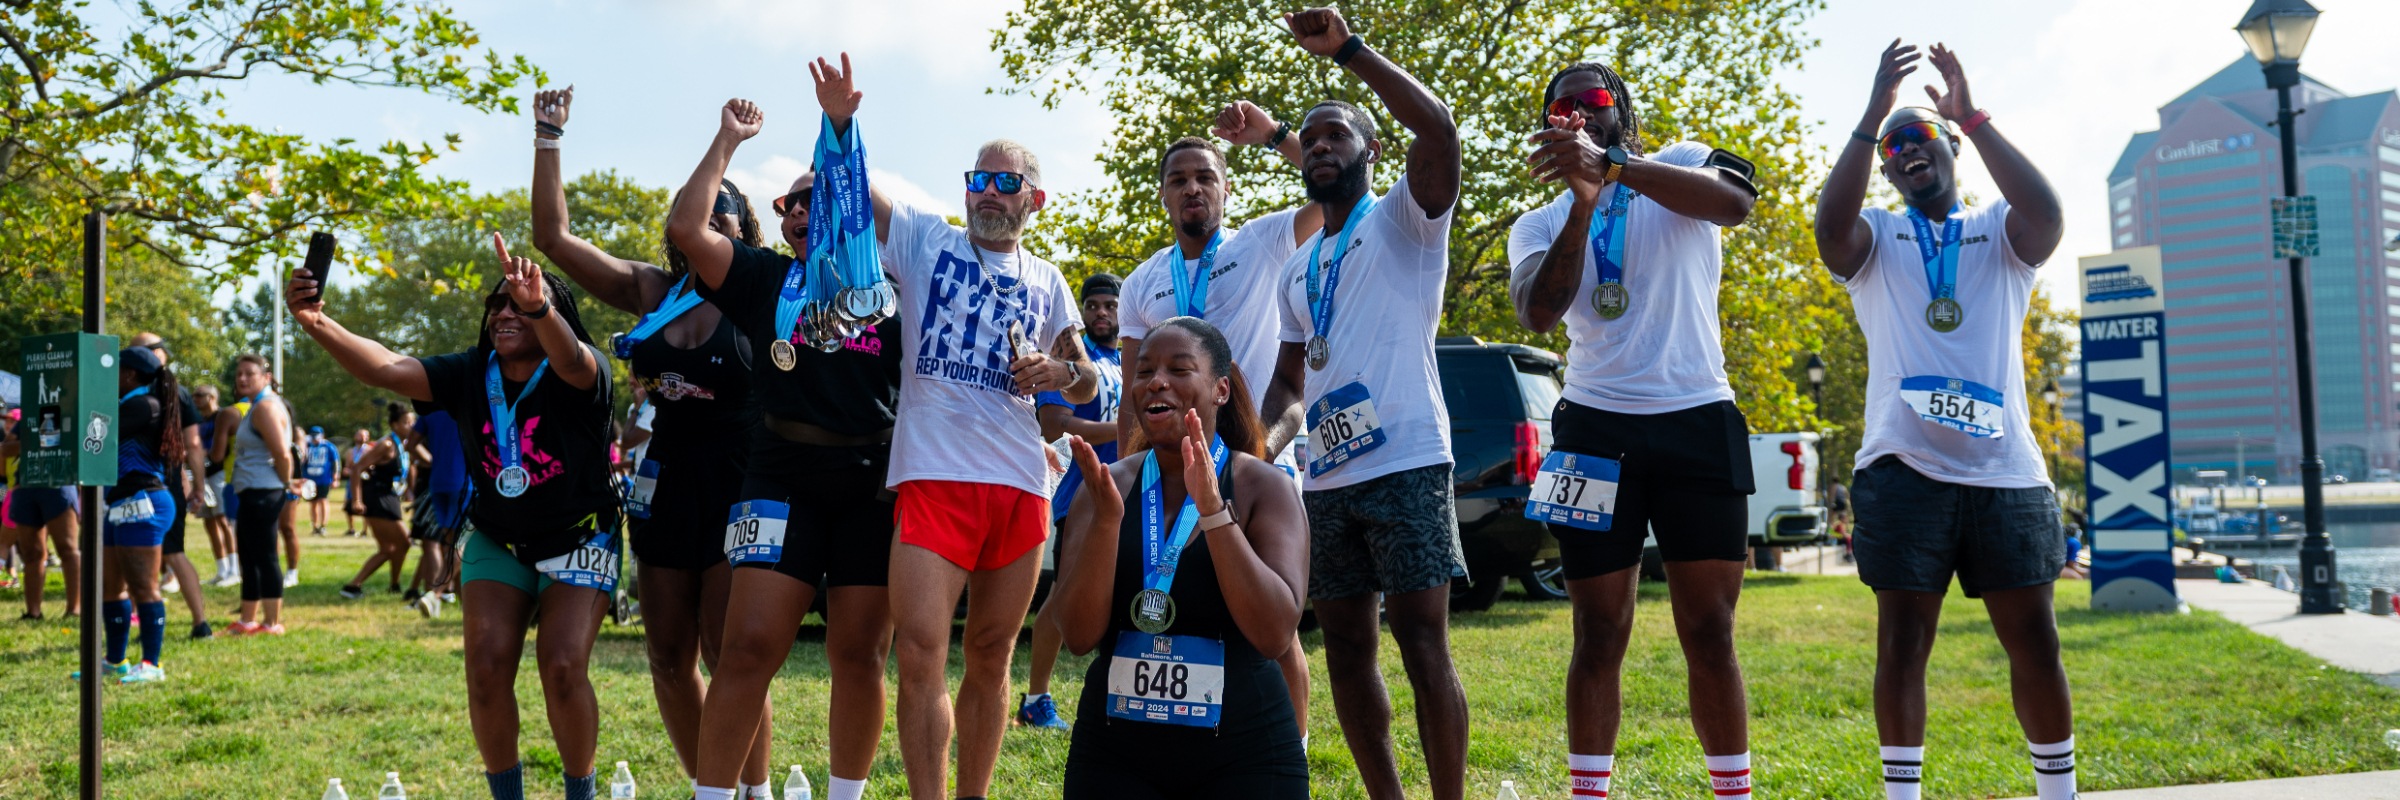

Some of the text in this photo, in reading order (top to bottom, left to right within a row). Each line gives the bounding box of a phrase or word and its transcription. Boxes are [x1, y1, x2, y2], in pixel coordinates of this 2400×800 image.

[838, 164, 847, 177] 5K
[2085, 317, 2158, 341] WATER
[26, 350, 72, 362] PLEASE CLEAN UP
[26, 360, 73, 371] AFTER YOUR DOG
[916, 358, 940, 376] REP
[942, 360, 979, 384] YOUR
[980, 370, 1010, 392] RUN
[1929, 392, 1976, 422] 554
[1320, 412, 1353, 452] 606
[28, 450, 38, 458] Dog
[2086, 340, 2168, 551] TAXI
[1547, 474, 1588, 506] 737
[120, 502, 140, 518] 731
[732, 518, 760, 548] 709
[1150, 526, 1158, 540] RUN
[564, 546, 601, 572] 702
[1150, 542, 1158, 566] CREW
[1134, 660, 1188, 700] 648
[1147, 704, 1168, 712] 2024
